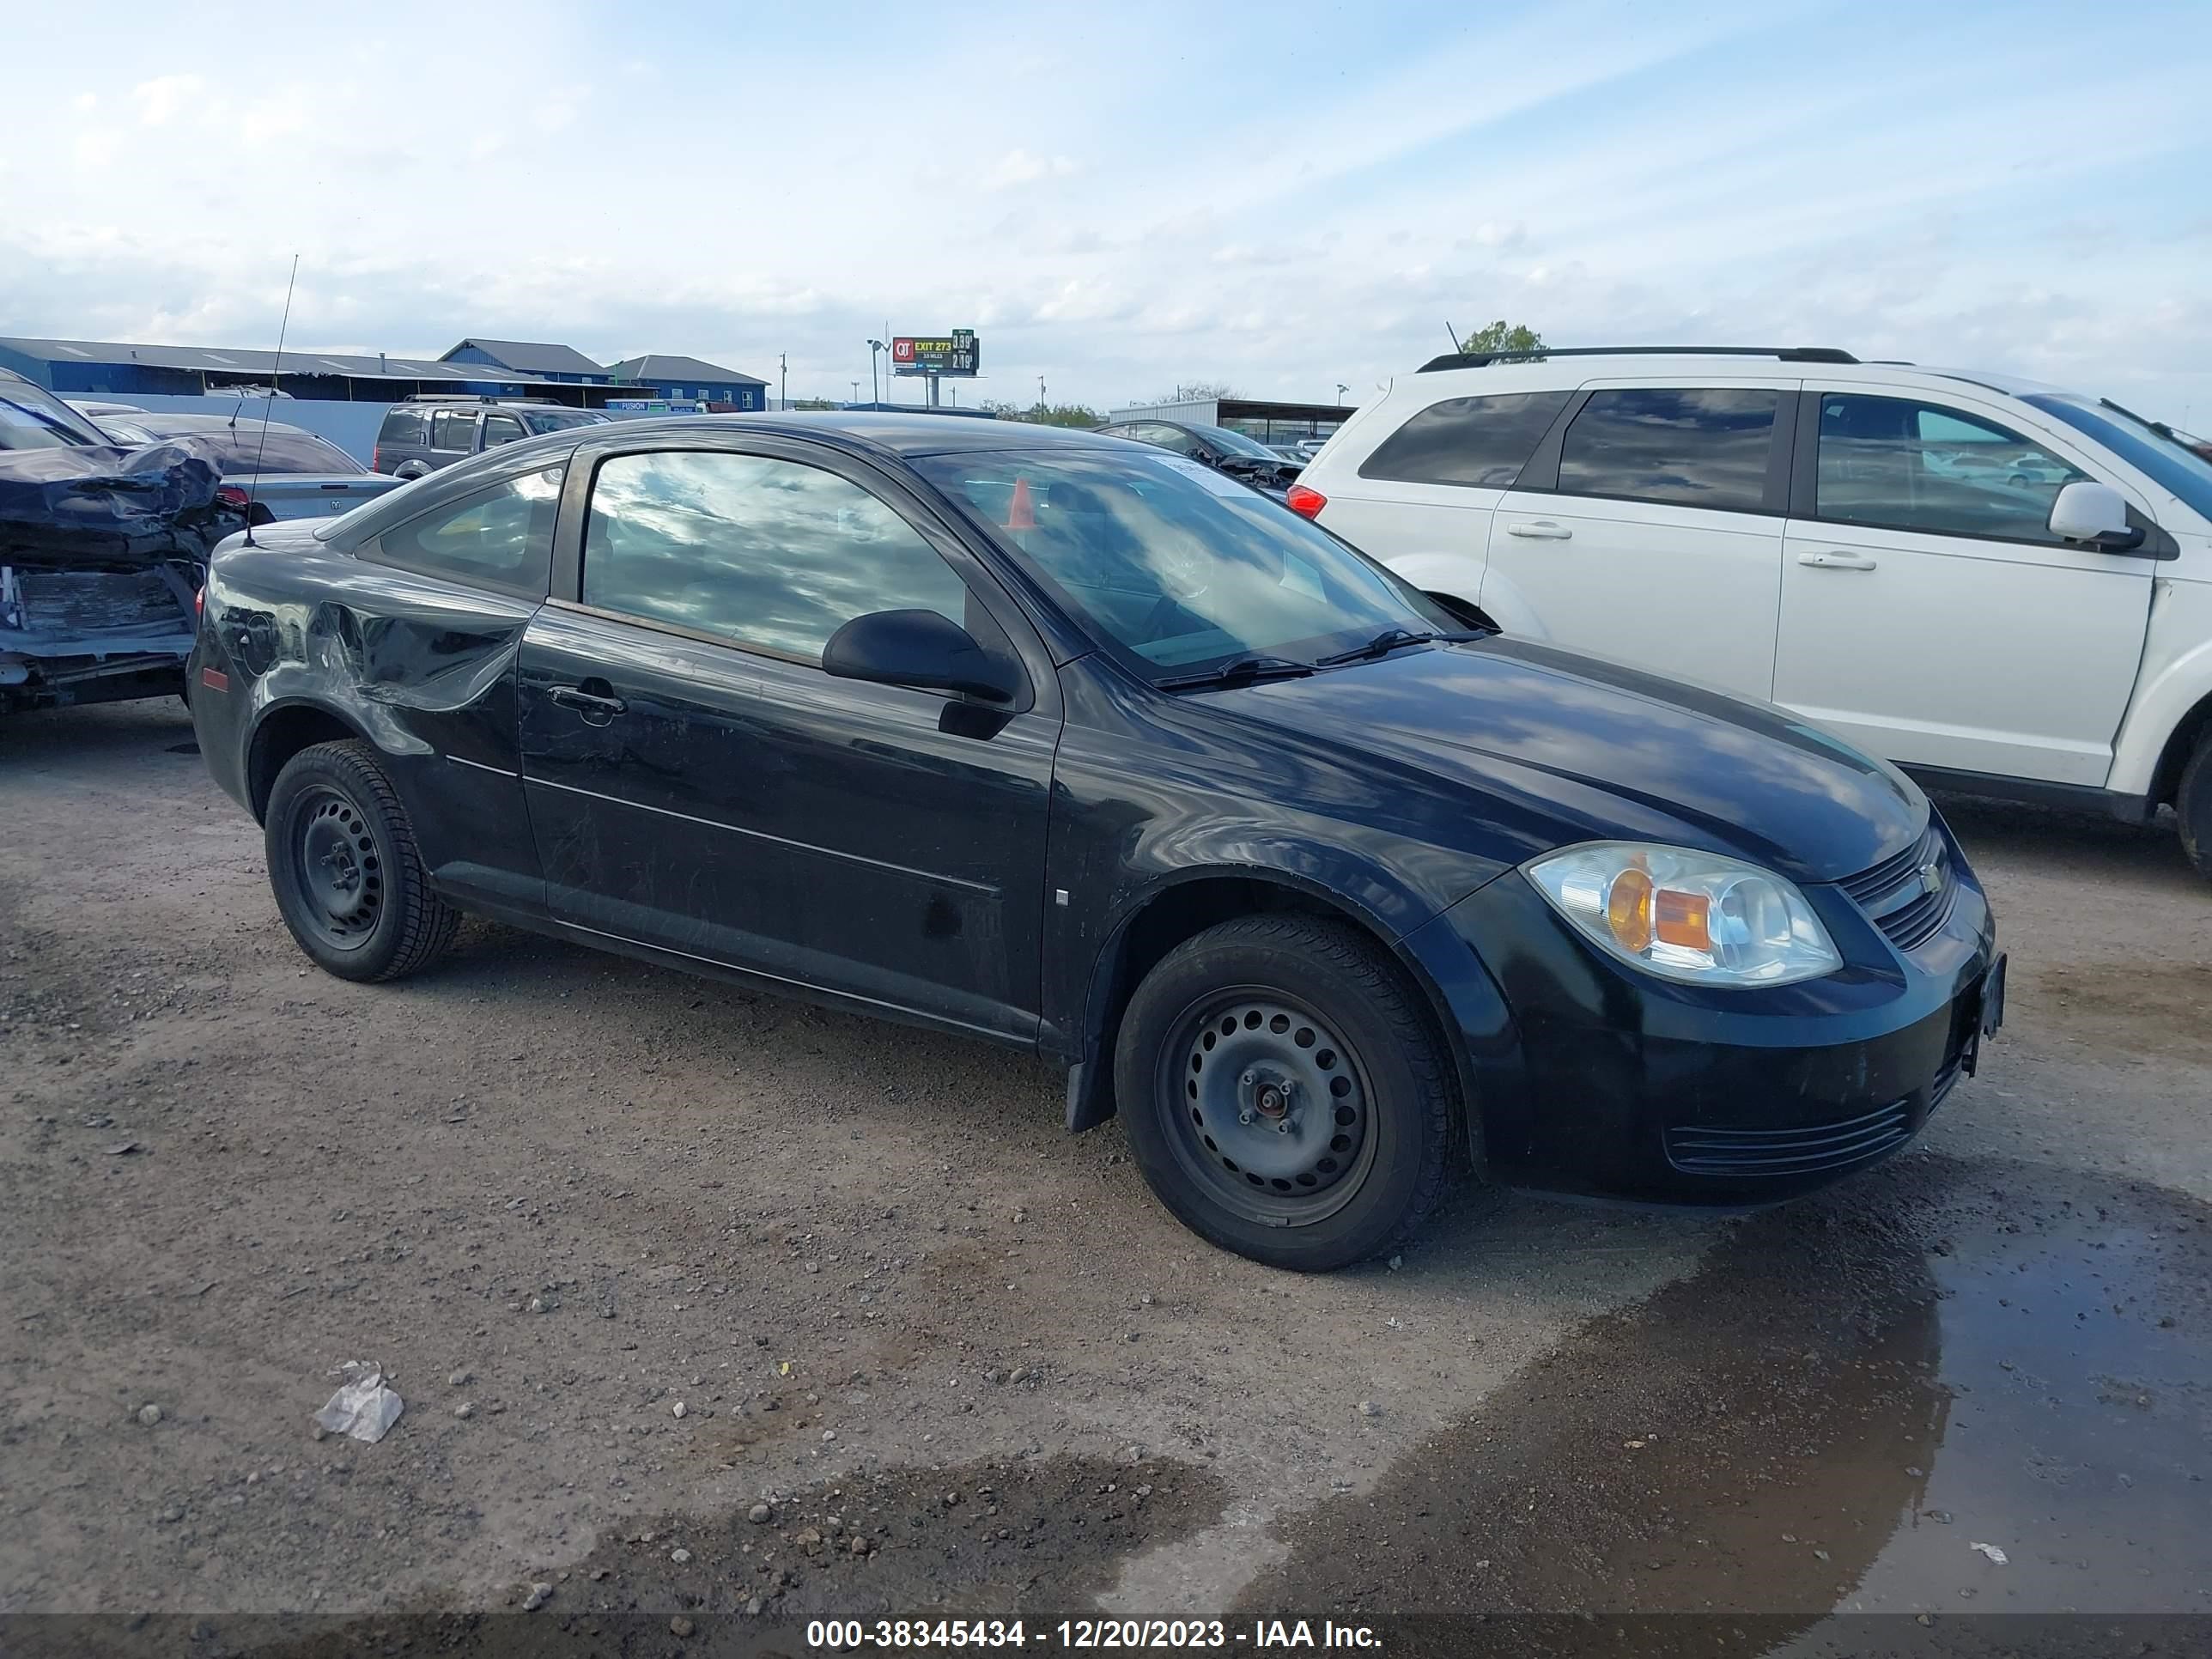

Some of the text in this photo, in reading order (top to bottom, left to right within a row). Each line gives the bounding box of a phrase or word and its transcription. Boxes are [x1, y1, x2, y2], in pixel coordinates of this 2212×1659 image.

[896, 343, 910, 357] QT
[915, 342, 951, 351] EXIT 273
[622, 402, 646, 410] FUSION
